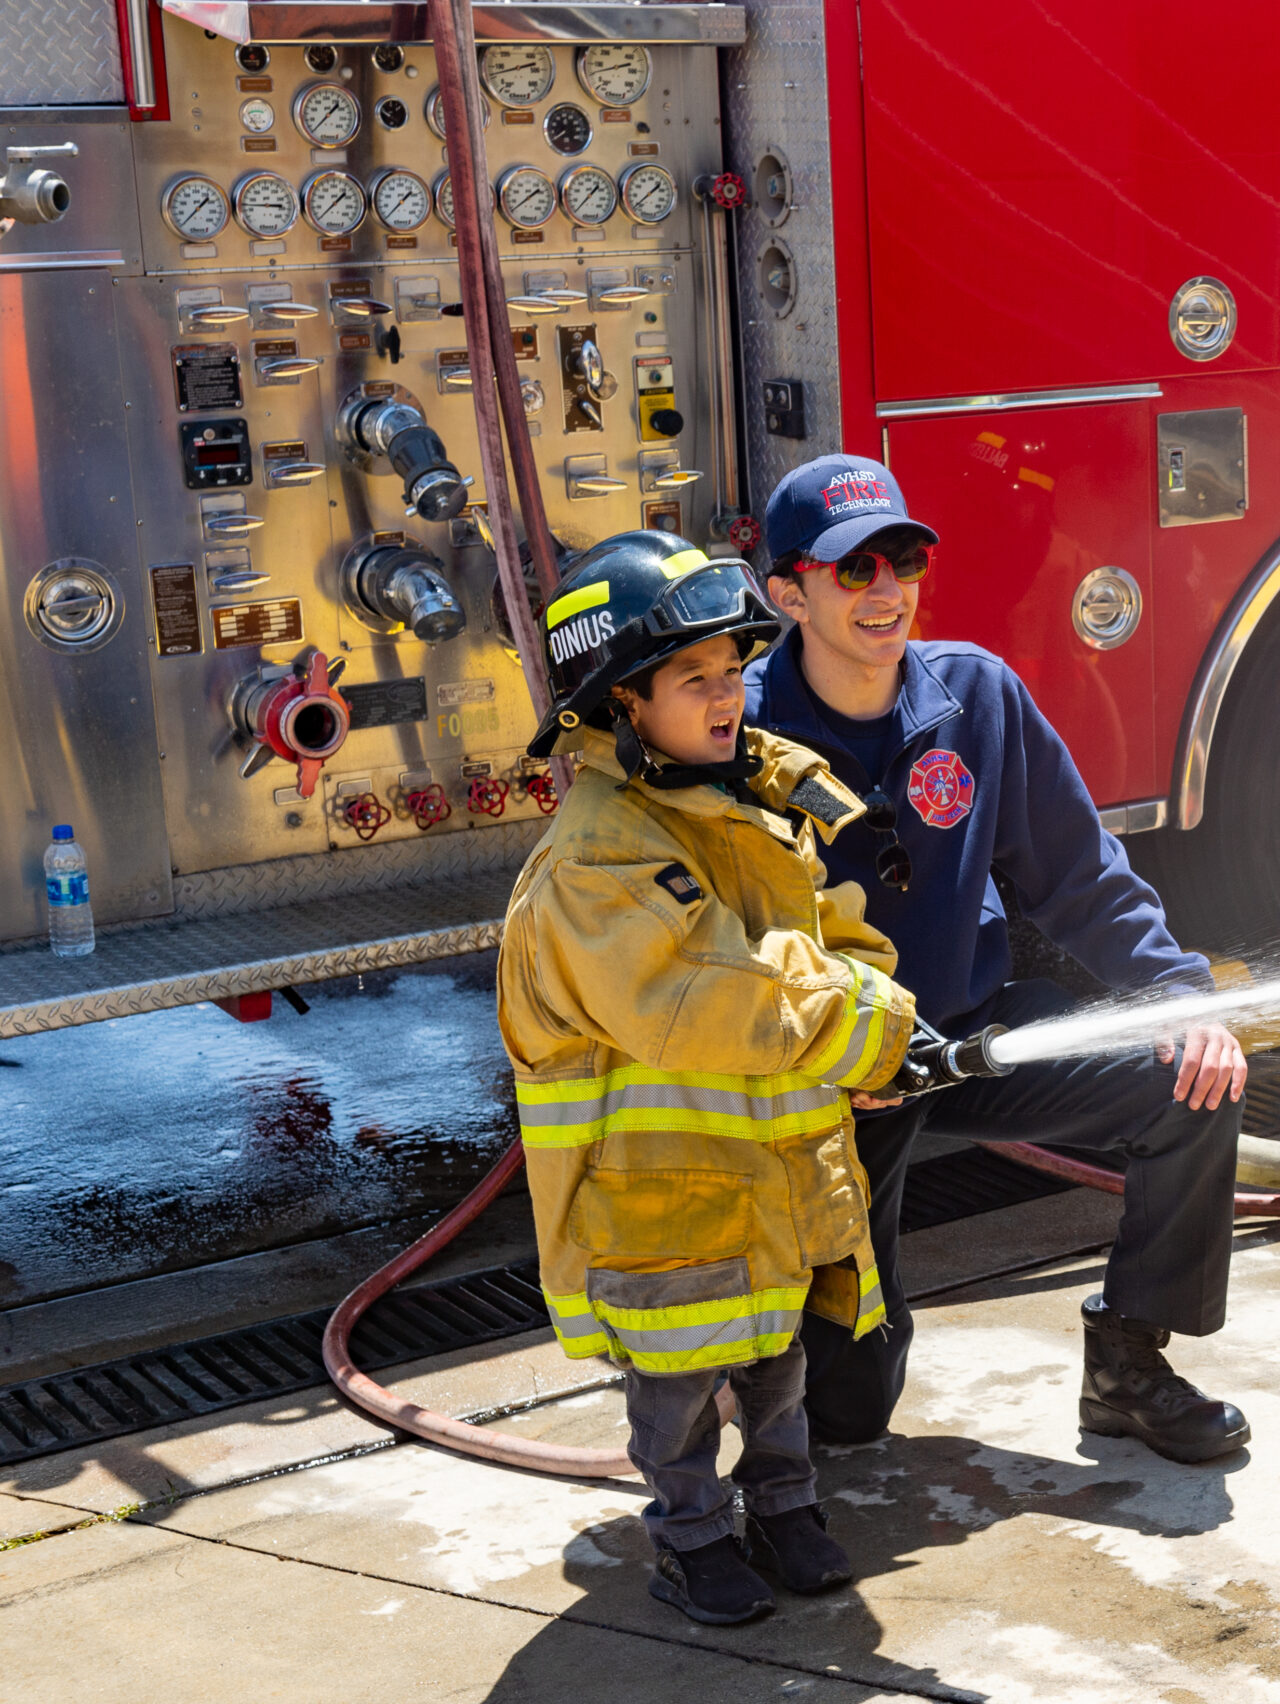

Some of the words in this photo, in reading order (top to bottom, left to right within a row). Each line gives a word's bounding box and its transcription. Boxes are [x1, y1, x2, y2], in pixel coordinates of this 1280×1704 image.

[829, 470, 876, 488] AVHSD
[820, 480, 891, 509] FIRE
[828, 498, 892, 515] TECHNOLOGY
[550, 610, 616, 665] DINIUS
[921, 754, 950, 768] AVHSD
[931, 813, 946, 822] FIRE
[946, 805, 963, 820] TECH
